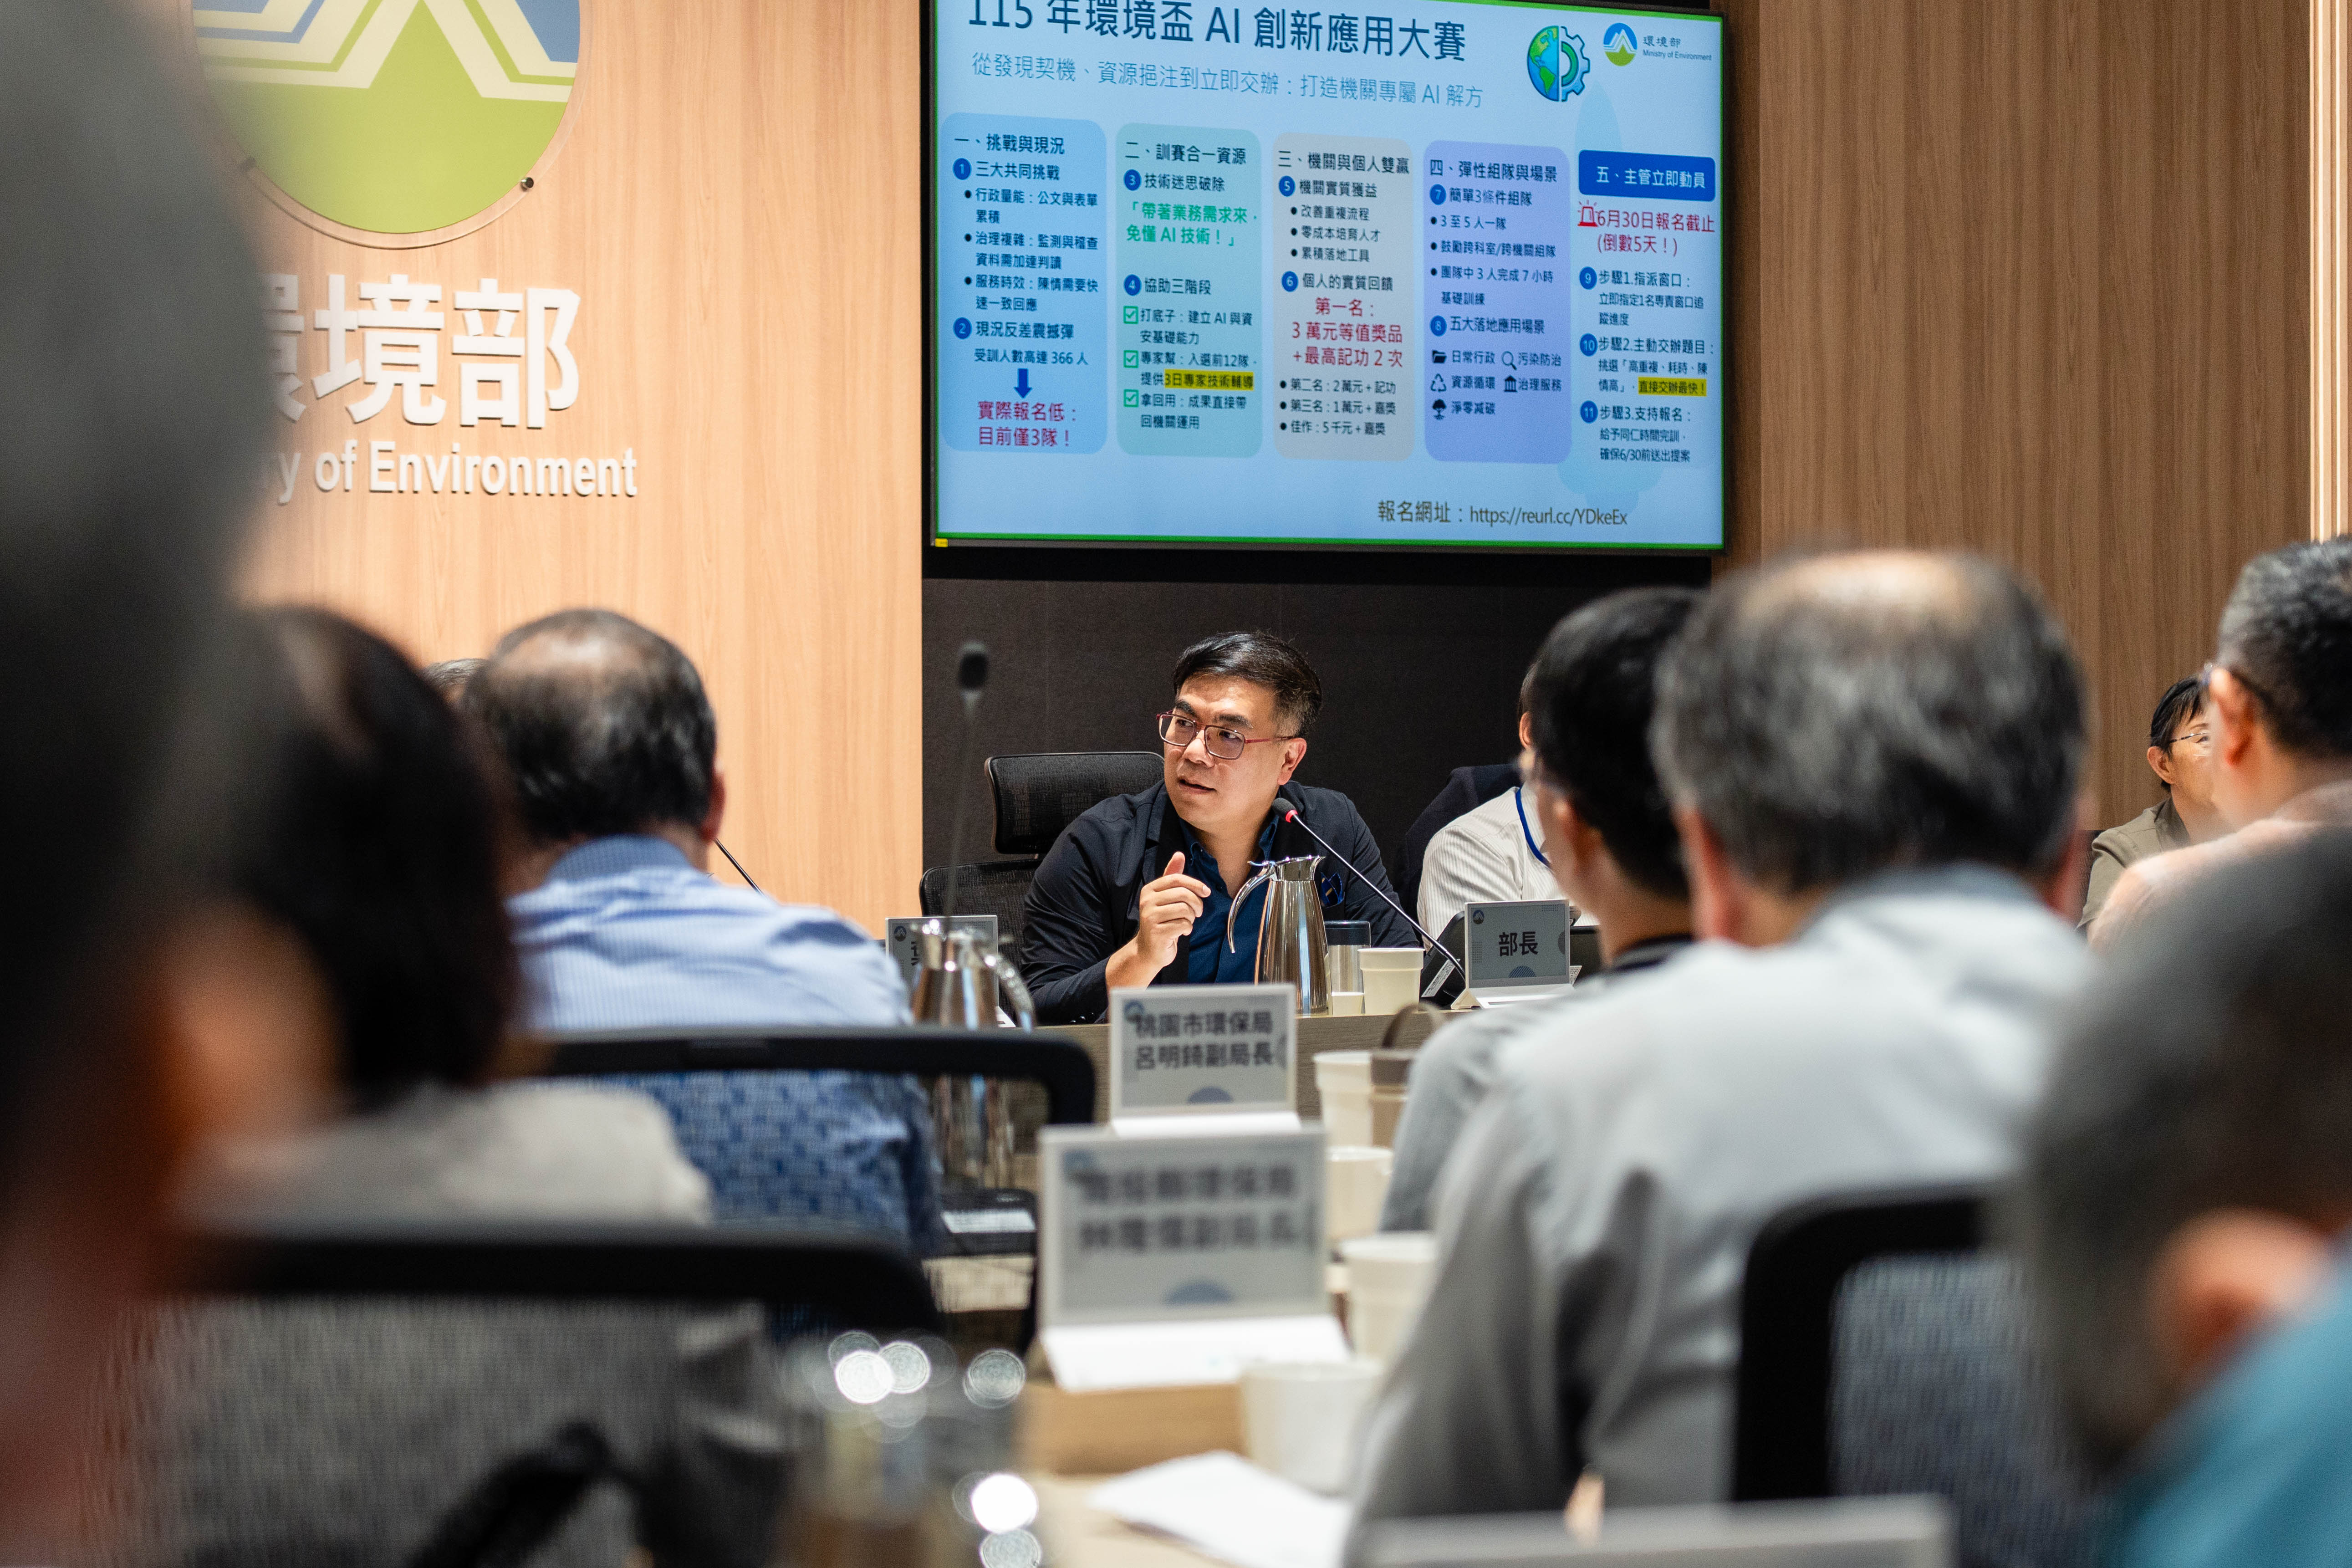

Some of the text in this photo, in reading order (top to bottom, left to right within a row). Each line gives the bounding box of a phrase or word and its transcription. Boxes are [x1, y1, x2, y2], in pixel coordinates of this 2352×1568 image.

[969, 0, 1466, 61] 115 年環境盃 AI 創新應用大賽
[1643, 35, 1681, 48] 環境部
[1643, 49, 1665, 59] Ministry
[1675, 51, 1712, 61] Environment
[1422, 84, 1439, 105] AI
[1446, 84, 1483, 108] 解方
[954, 133, 1065, 154] 一、挑戰與現況
[1125, 142, 1246, 164] 二、訓賽合一資源
[976, 161, 1060, 180] 三大共同挑戰
[1278, 151, 1409, 174] 三、機關與個人雙贏
[1430, 159, 1557, 182] 四、彈性組隊與場景
[1145, 173, 1225, 192] 技術迷思破除
[1596, 166, 1705, 189] 五、主管立即動員
[1300, 179, 1377, 198] 機關實質獲益
[976, 209, 1000, 224] 累積
[1301, 204, 1369, 221] 改善重複流程
[1597, 210, 1715, 233] 6月30日報名截止
[1127, 224, 1156, 242] 免懂
[1161, 227, 1176, 242] AI
[1301, 225, 1381, 242] 零成本培育人才
[1302, 246, 1370, 262] 累積落地工具
[1144, 277, 1211, 295] 協助三階段
[976, 296, 1037, 312] 速一致回應
[1315, 297, 1373, 317] 第一名：
[1442, 291, 1485, 305] 基礎訓練
[1214, 312, 1226, 324] AI
[1450, 316, 1545, 334] 五大落地應用場景
[1140, 330, 1199, 345] 安基礎能力
[1292, 322, 1403, 343] 3 萬元等值獎品
[1051, 352, 1073, 364] 366
[1077, 351, 1089, 365] 人
[1374, 350, 1383, 366] 2
[1388, 349, 1403, 368] 次
[1452, 350, 1561, 366] 日常行政 污染防治
[1451, 375, 1562, 392] 資源循環 治理服務
[978, 401, 1076, 422] 實際報名低：
[1451, 401, 1495, 415] 淨零減碳
[980, 427, 1069, 447] 目前僅3隊！
[315, 439, 358, 492] of
[369, 440, 638, 498] Environment
[1498, 931, 1538, 956] 部長
